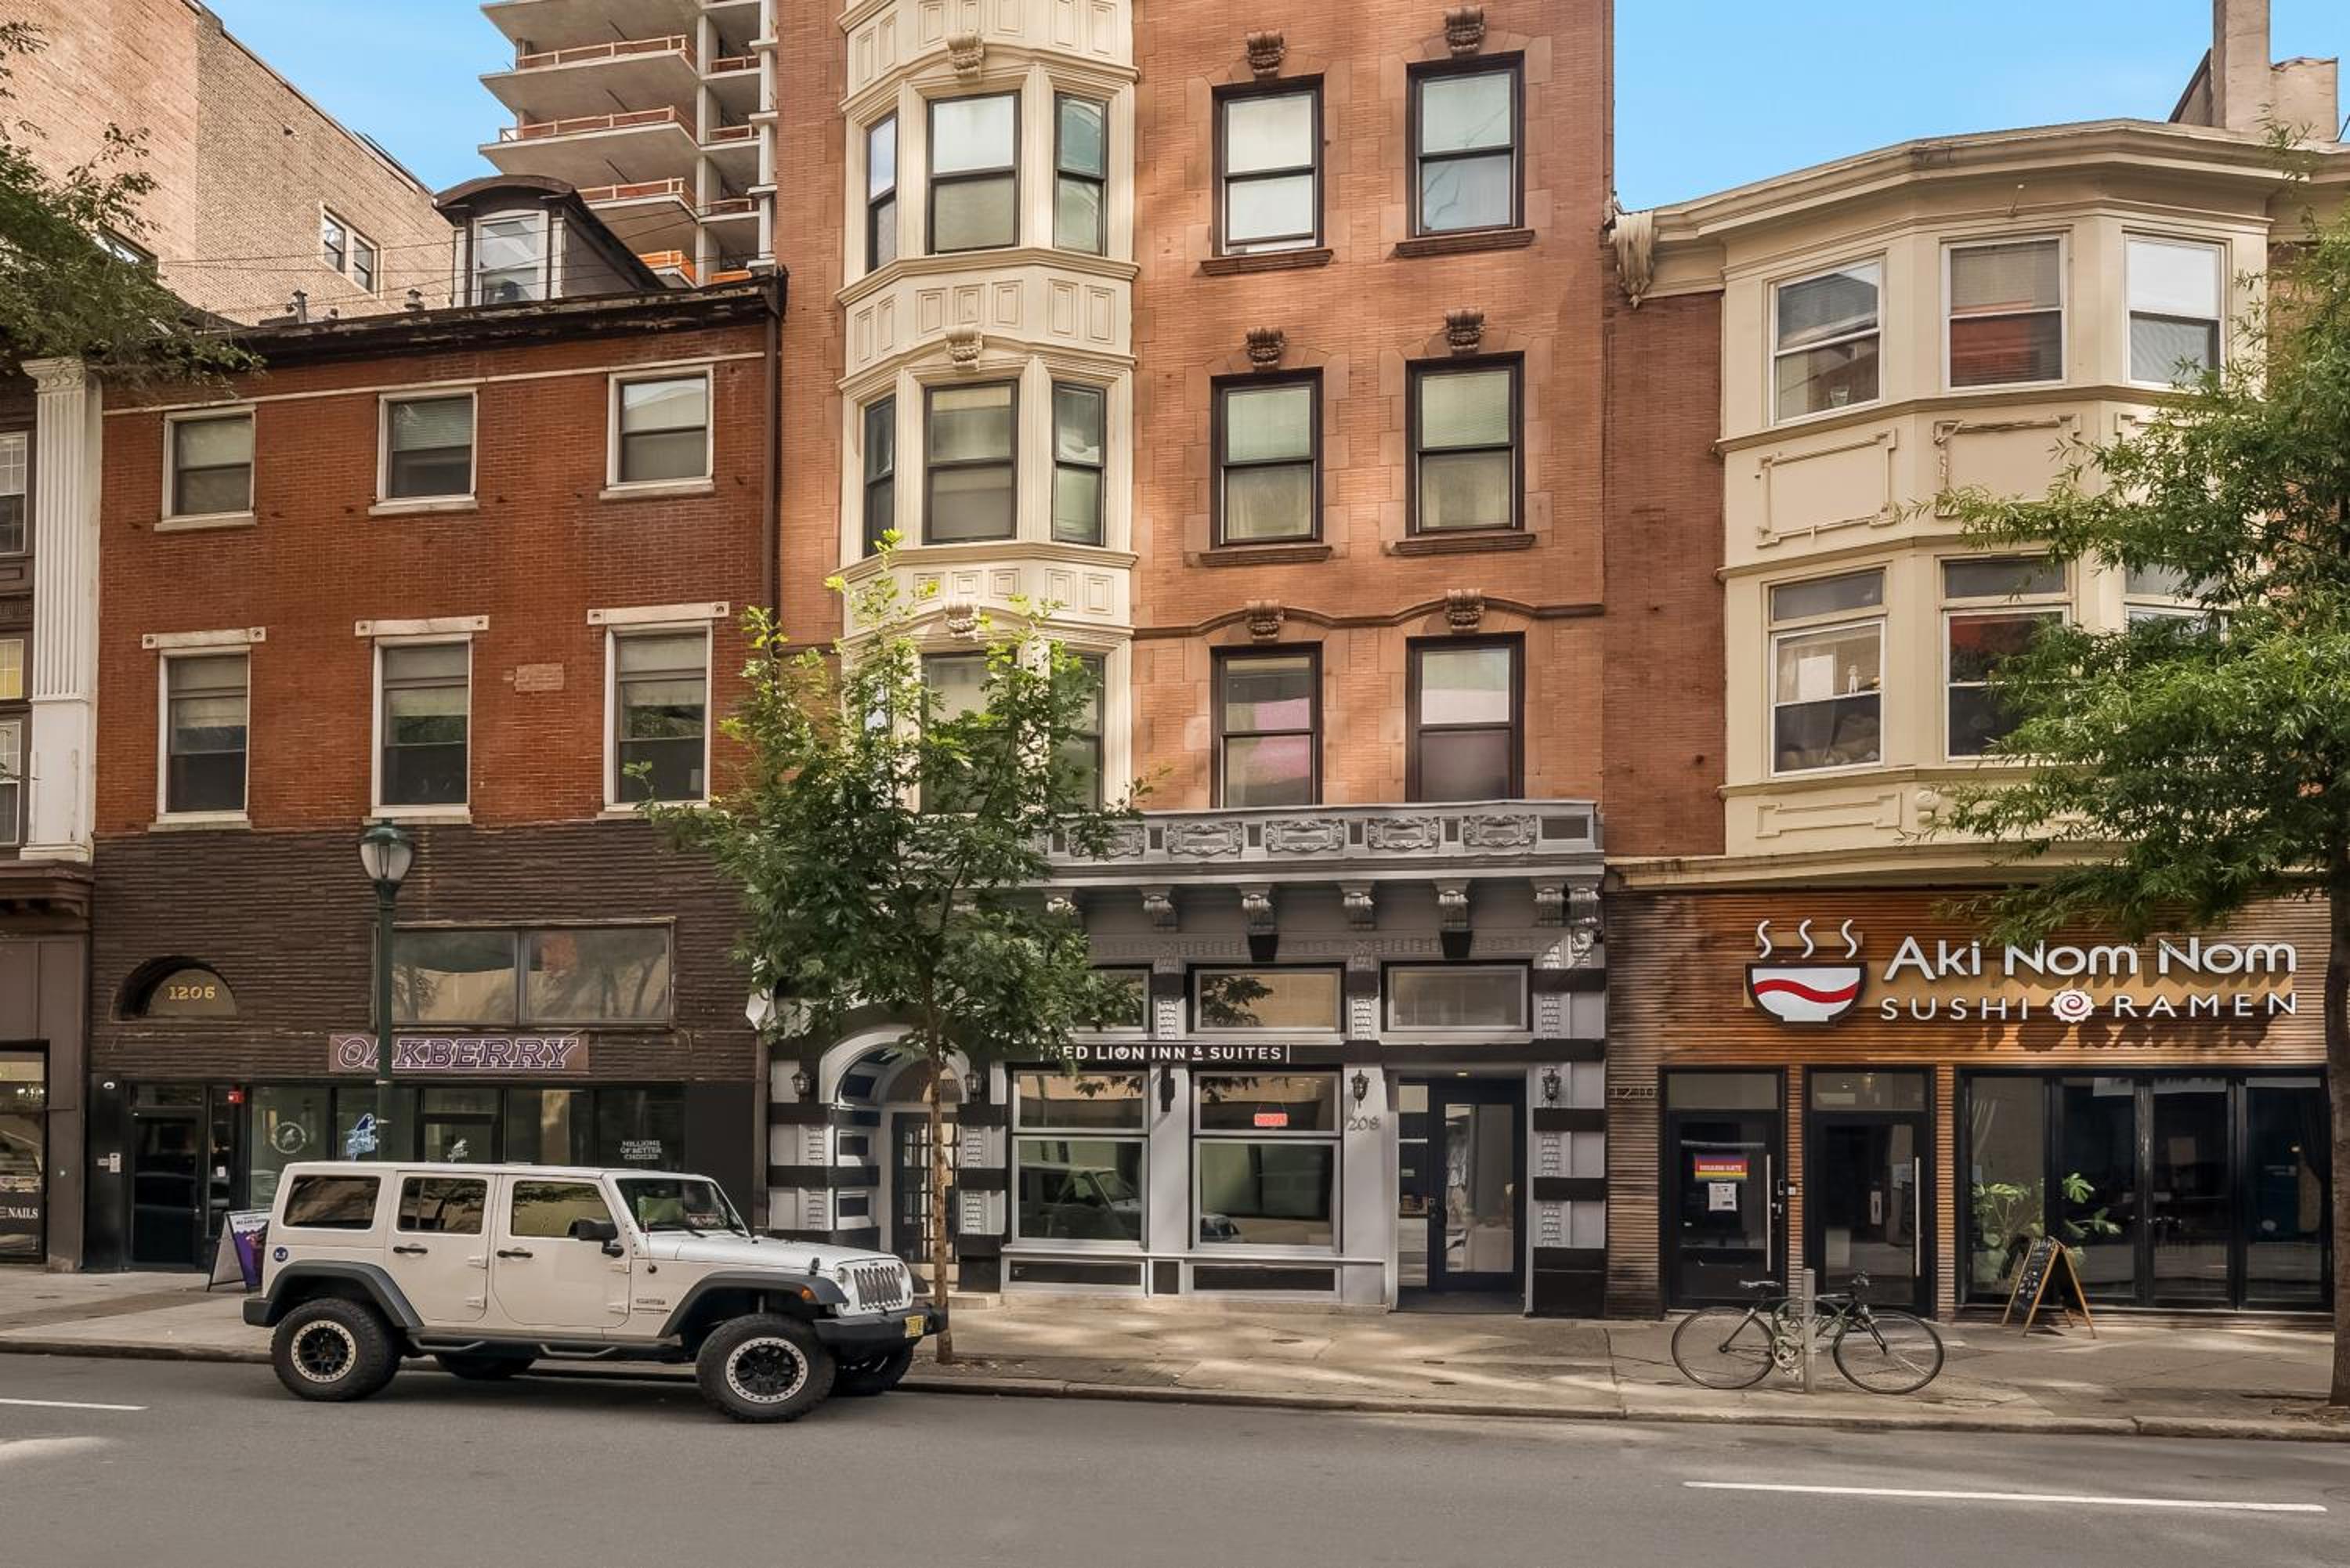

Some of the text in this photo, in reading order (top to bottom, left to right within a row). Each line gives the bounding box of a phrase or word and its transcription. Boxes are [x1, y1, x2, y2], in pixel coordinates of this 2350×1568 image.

[1882, 935, 2297, 981] Aki Nom Nom
[168, 986, 215, 1000] 1206
[1880, 992, 2297, 1021] SUSHI RAMEN
[1050, 1045, 1282, 1060] ED LION INN & SUITES
[8, 1206, 38, 1219] NAILS
